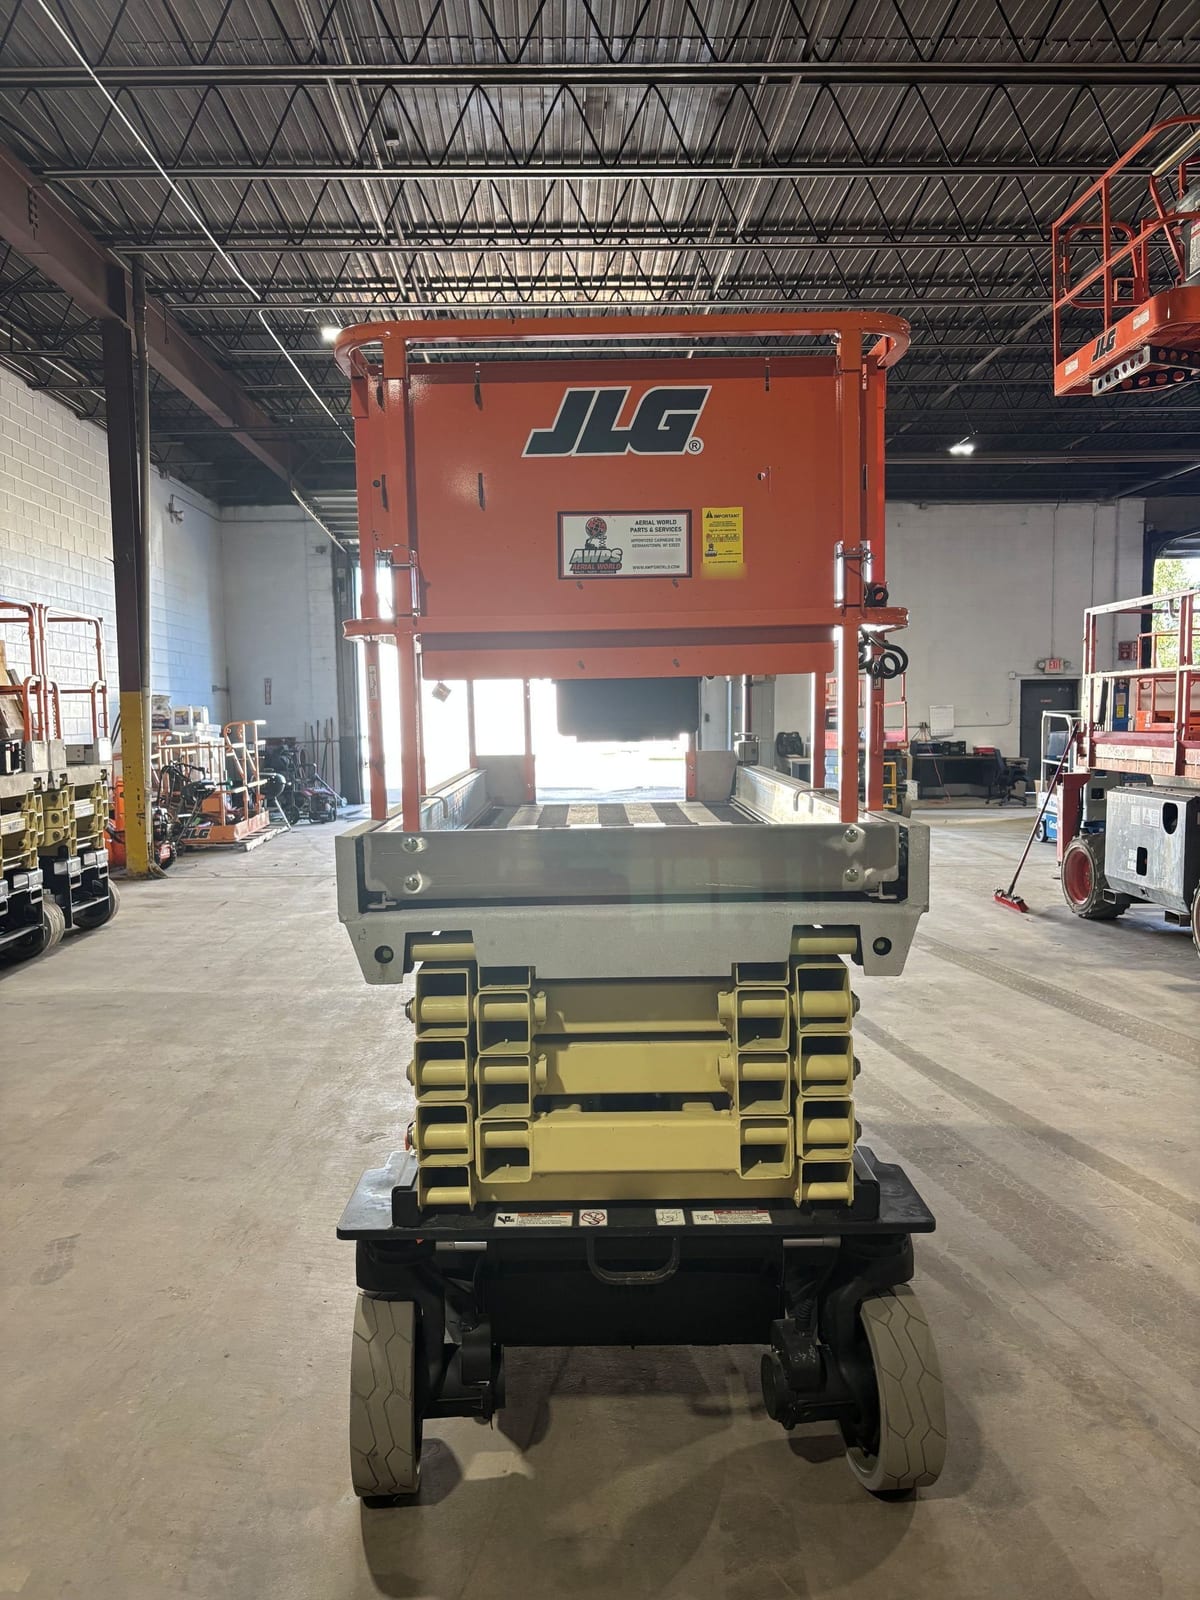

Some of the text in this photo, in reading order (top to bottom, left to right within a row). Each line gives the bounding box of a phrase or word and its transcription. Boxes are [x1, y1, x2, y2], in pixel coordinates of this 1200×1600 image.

[1091, 328, 1117, 364] JLG
[521, 385, 712, 457] JLG
[569, 548, 623, 564] AWPS
[570, 562, 622, 571] AERIAL WORLD
